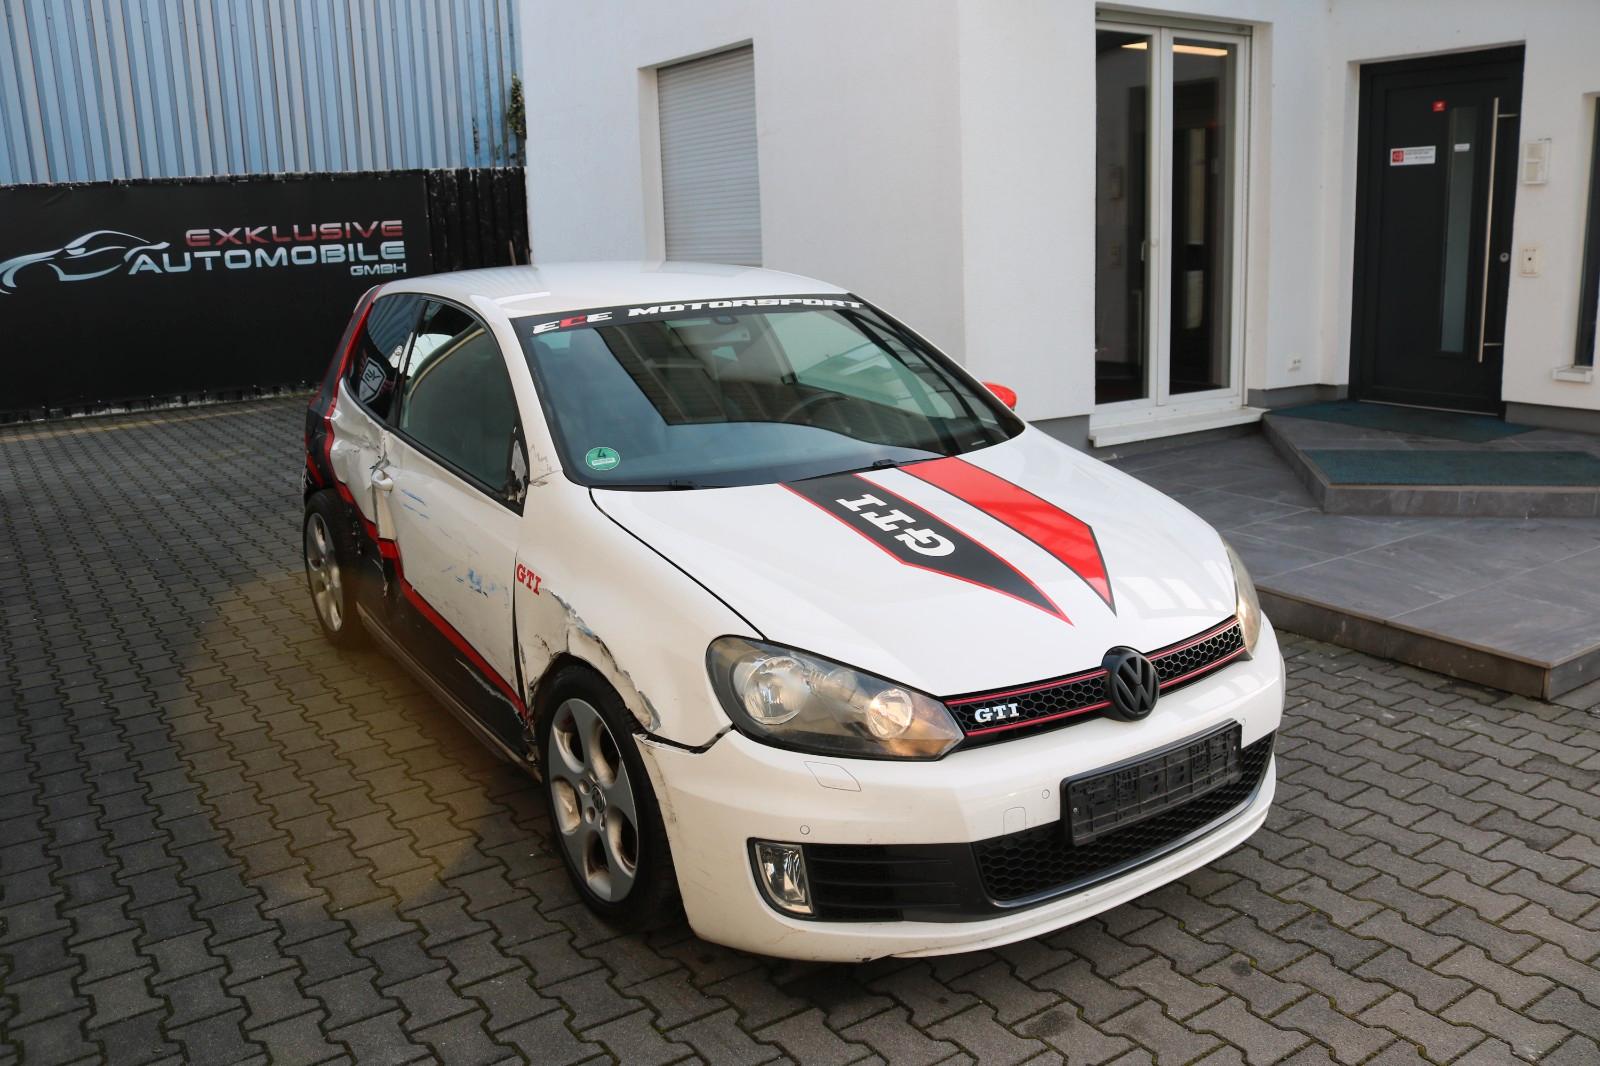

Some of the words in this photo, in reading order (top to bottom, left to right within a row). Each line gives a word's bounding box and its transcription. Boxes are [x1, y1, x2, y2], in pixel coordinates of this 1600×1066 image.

[185, 219, 403, 247] EXKLUSIVE
[128, 240, 406, 275] AUTOMOBILE
[350, 263, 407, 276] GMBH
[532, 311, 613, 335] ECE
[627, 298, 864, 317] MOTORSPORT
[835, 493, 956, 557] GTI
[516, 563, 542, 596] GTI
[974, 703, 1020, 724] GTI
